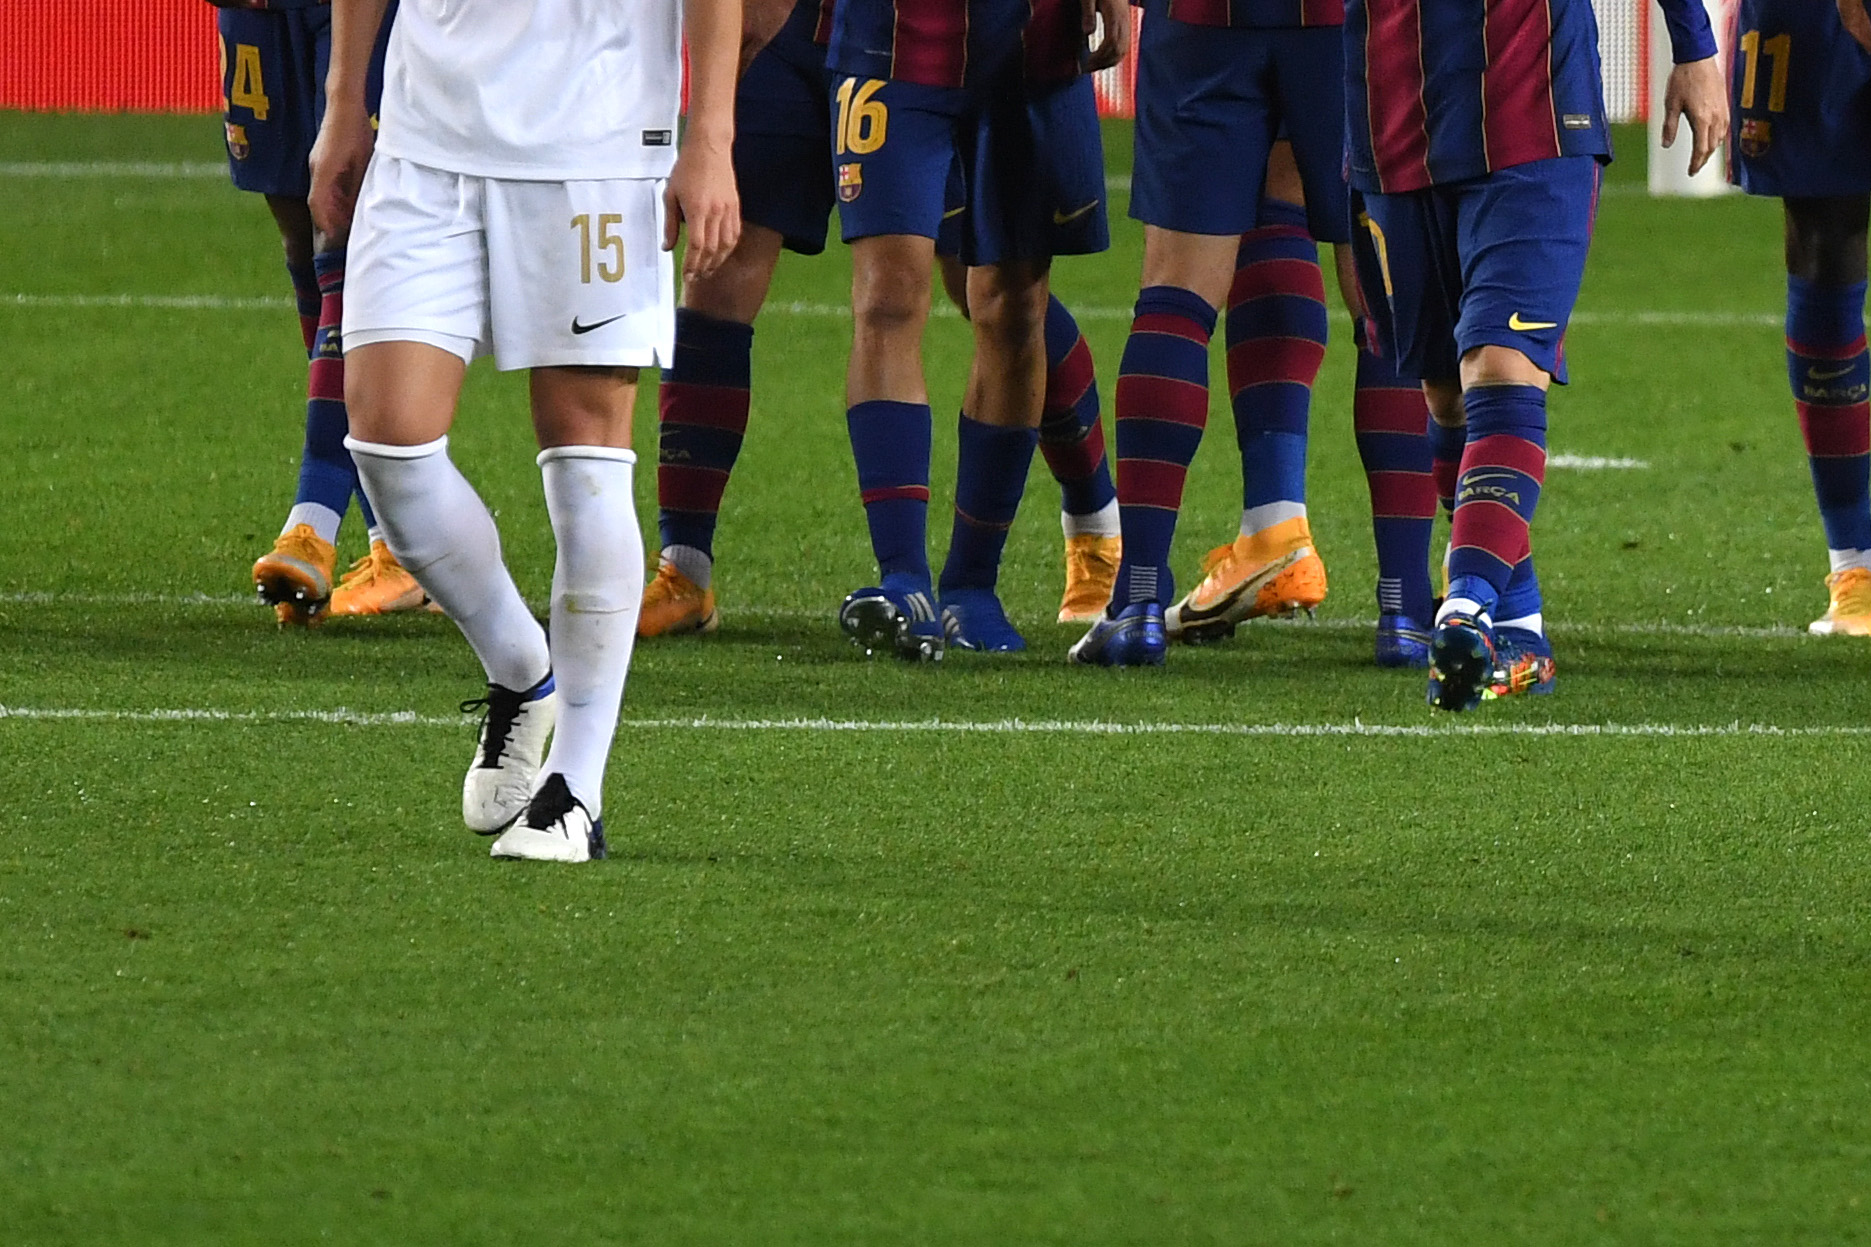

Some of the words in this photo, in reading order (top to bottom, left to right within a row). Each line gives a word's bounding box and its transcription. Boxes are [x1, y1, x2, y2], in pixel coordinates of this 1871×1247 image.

[1740, 29, 1791, 112] 11
[836, 77, 889, 155] 16
[570, 213, 626, 284] 15
